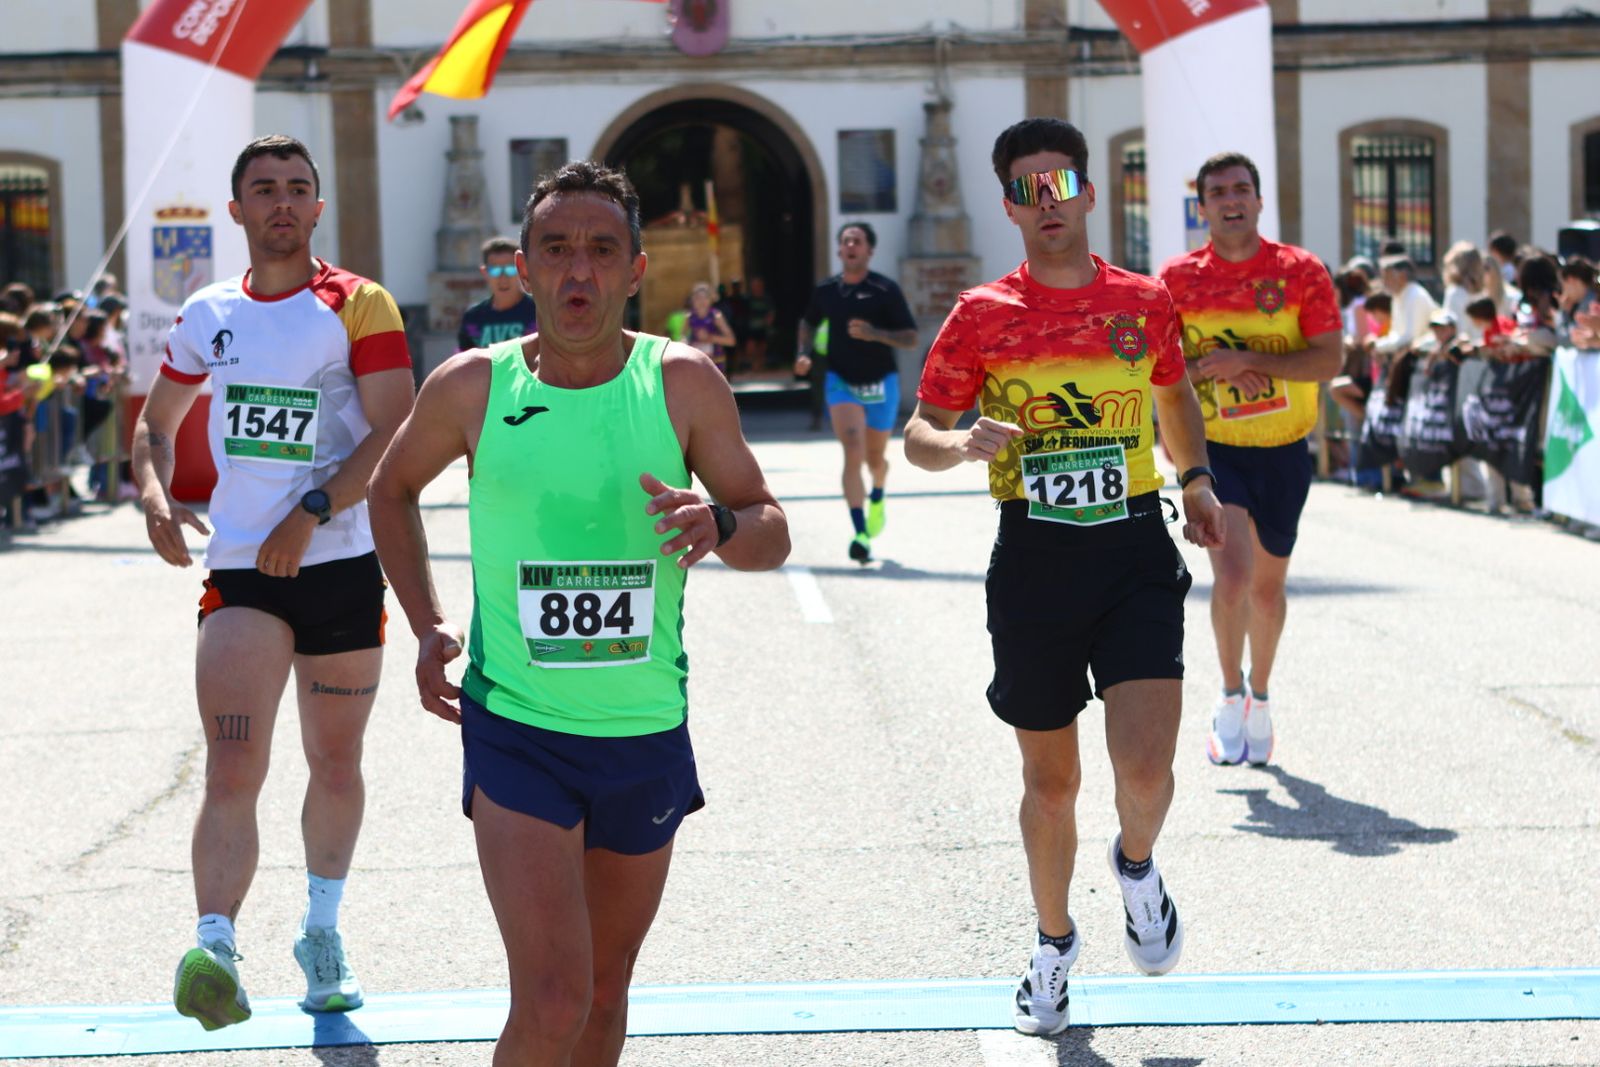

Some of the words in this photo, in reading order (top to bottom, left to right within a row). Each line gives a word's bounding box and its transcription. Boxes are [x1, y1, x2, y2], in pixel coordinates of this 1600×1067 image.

[248, 393, 292, 405] CARRERA
[227, 404, 314, 442] 1547
[1060, 434, 1117, 449] FERNANDO
[1051, 459, 1098, 471] CARRERA
[1030, 469, 1124, 506] 1218
[522, 567, 553, 586] XIV
[557, 567, 579, 576] SAN
[556, 576, 619, 587] CARRERA
[540, 591, 634, 637] 884
[215, 714, 251, 742] XIII
